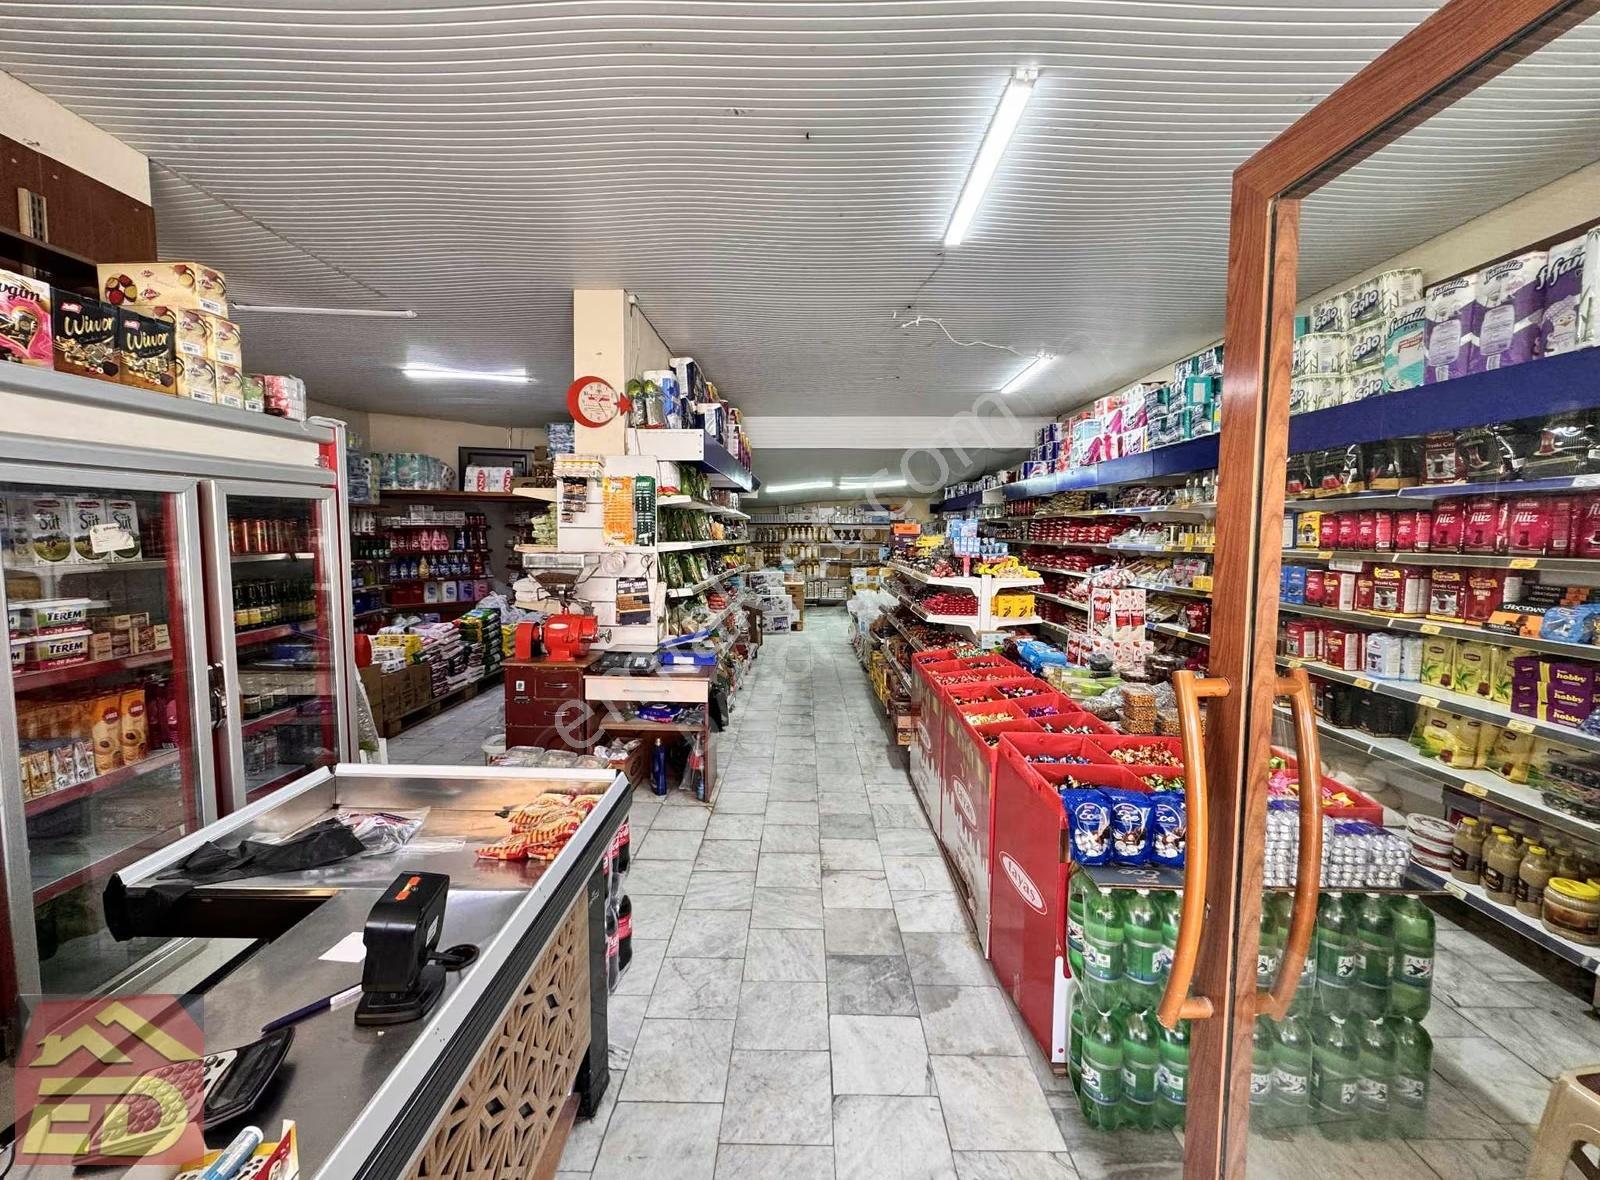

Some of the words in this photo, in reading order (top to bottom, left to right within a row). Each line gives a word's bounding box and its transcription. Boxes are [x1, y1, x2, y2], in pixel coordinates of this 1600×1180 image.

[1484, 260, 1523, 285] familia
[1432, 278, 1469, 301] familia
[1350, 289, 1378, 318] Solo
[64, 314, 115, 336] Wiwor
[1315, 307, 1338, 331] Solo
[126, 327, 169, 350] Wiwor
[1352, 334, 1380, 361] Solo
[1355, 379, 1383, 400] Solo
[39, 512, 61, 531] Süt
[79, 511, 101, 530] Süt
[113, 511, 133, 530] Süt
[1436, 513, 1456, 525] filiz
[1470, 512, 1492, 523] filiz
[1513, 511, 1539, 523] filiz
[47, 608, 82, 622] TEREM
[49, 641, 83, 654] TEREM
[1556, 672, 1587, 683] hobby
[1554, 692, 1584, 704] hobby
[1553, 711, 1585, 723] hobby
